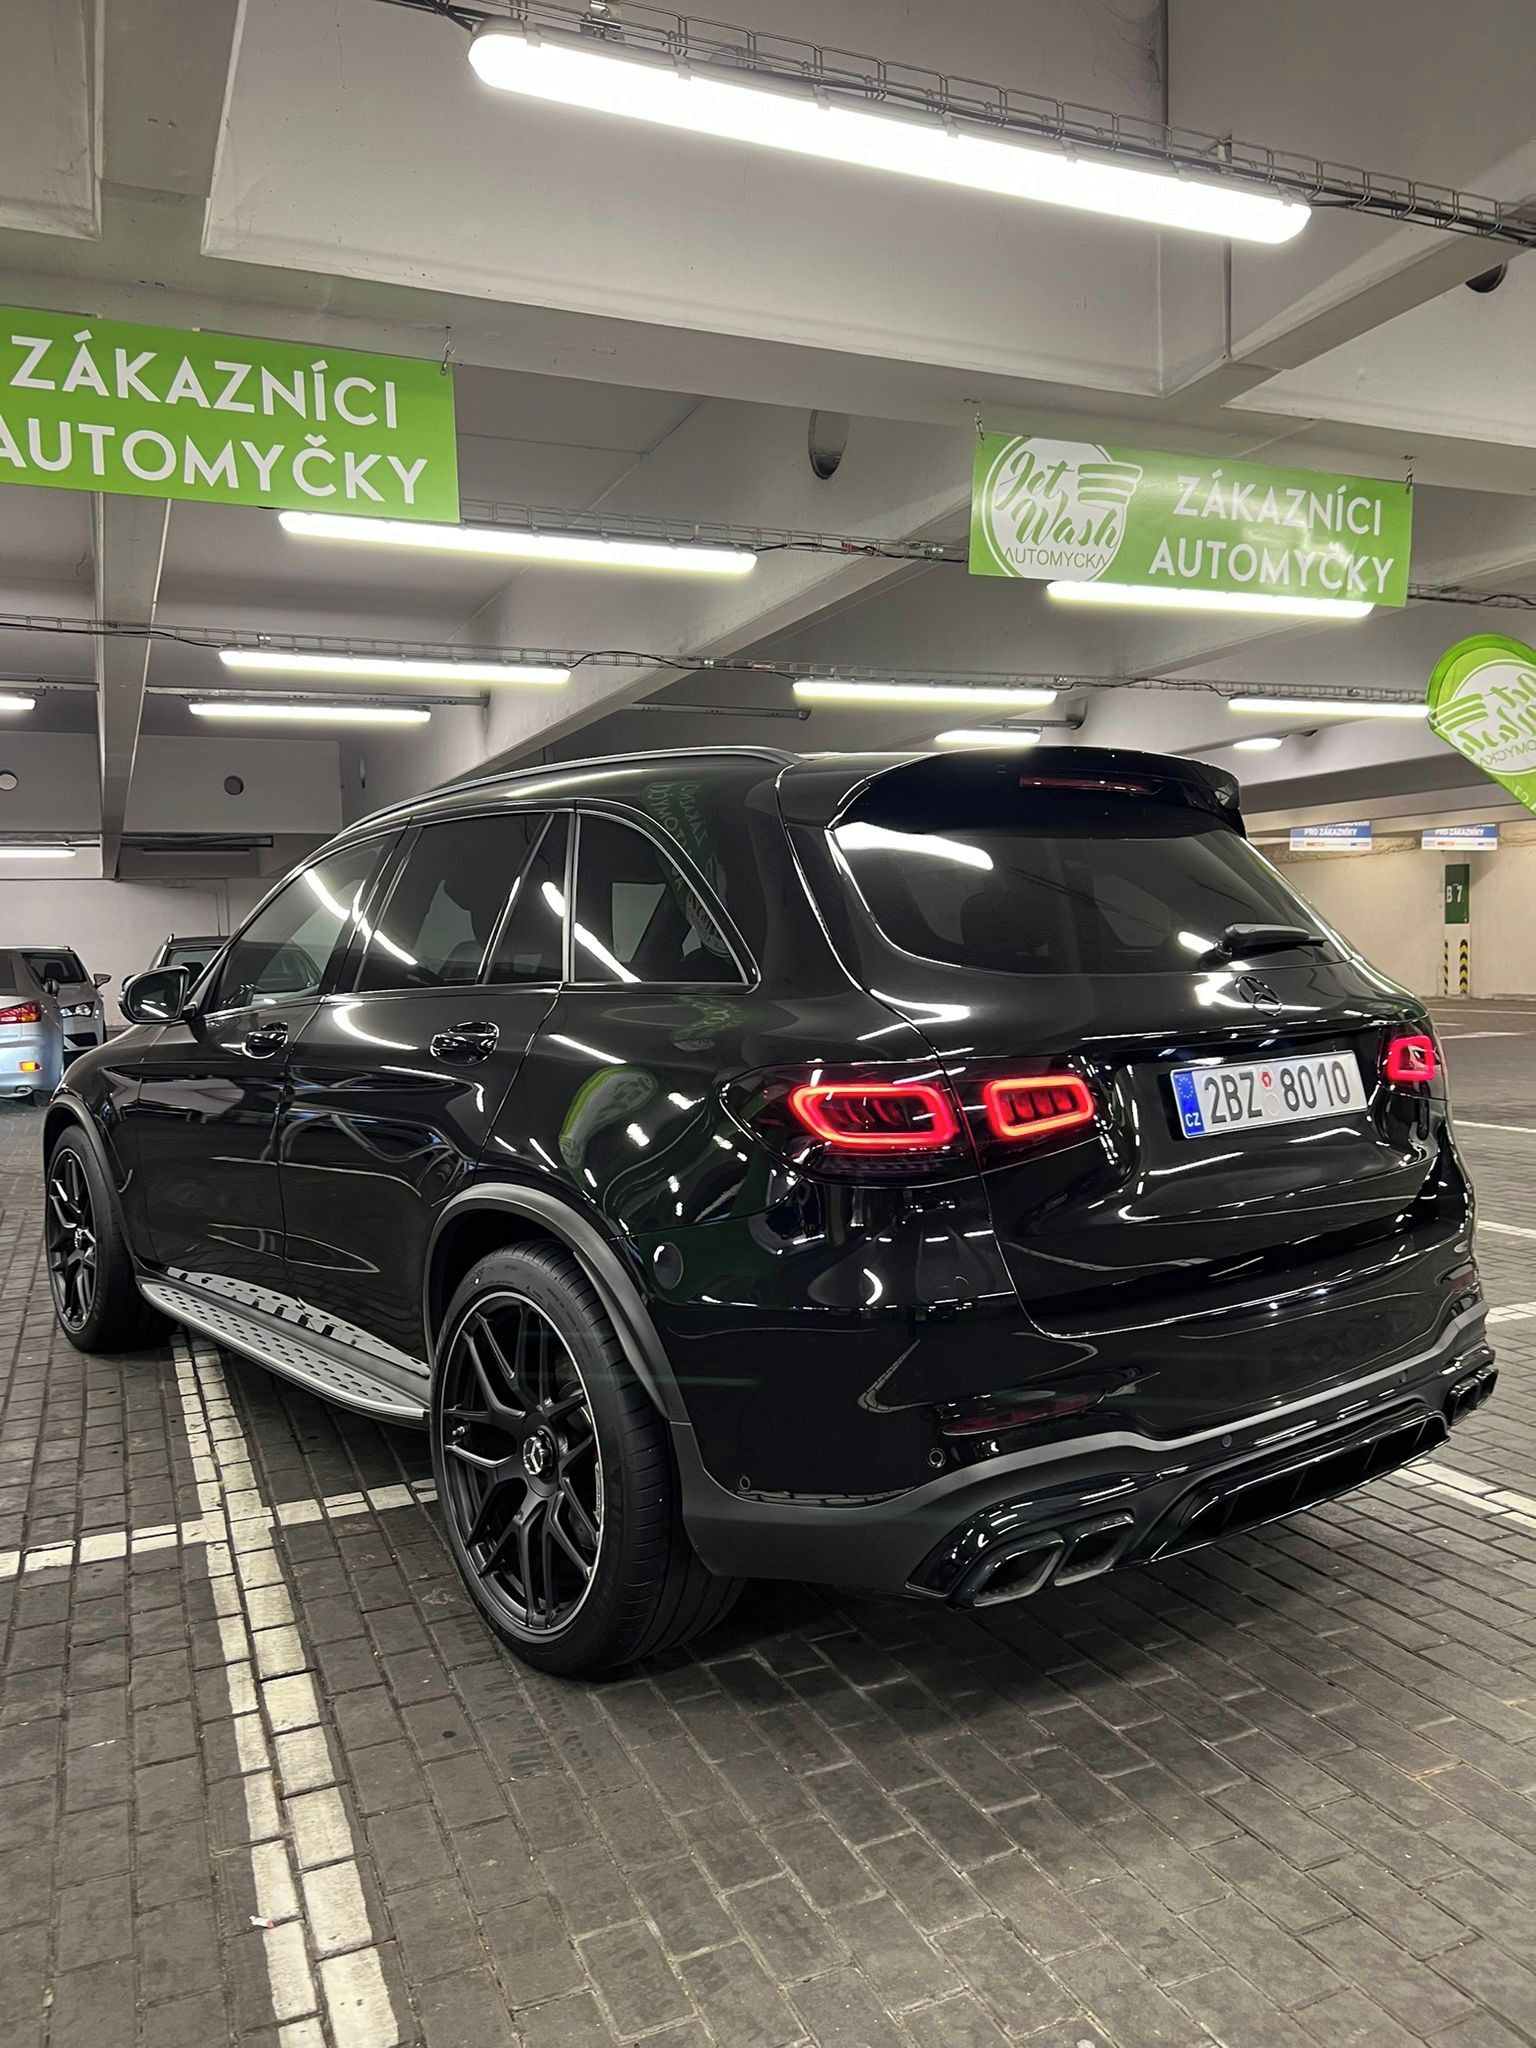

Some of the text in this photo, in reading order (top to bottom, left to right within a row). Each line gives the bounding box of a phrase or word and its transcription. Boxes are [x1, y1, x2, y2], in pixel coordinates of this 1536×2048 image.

[10, 329, 398, 430] ZÁKAZNÍCI
[0, 413, 428, 505] AUTOMYČKY
[994, 450, 1075, 511] Jet
[1011, 490, 1118, 549] Wash
[1173, 468, 1382, 536] ZÁKAZNÍCI
[1148, 536, 1395, 594] AUTOMYČKY
[1184, 1112, 1202, 1127] CZ
[1204, 1061, 1351, 1124] 2BZ 8010
